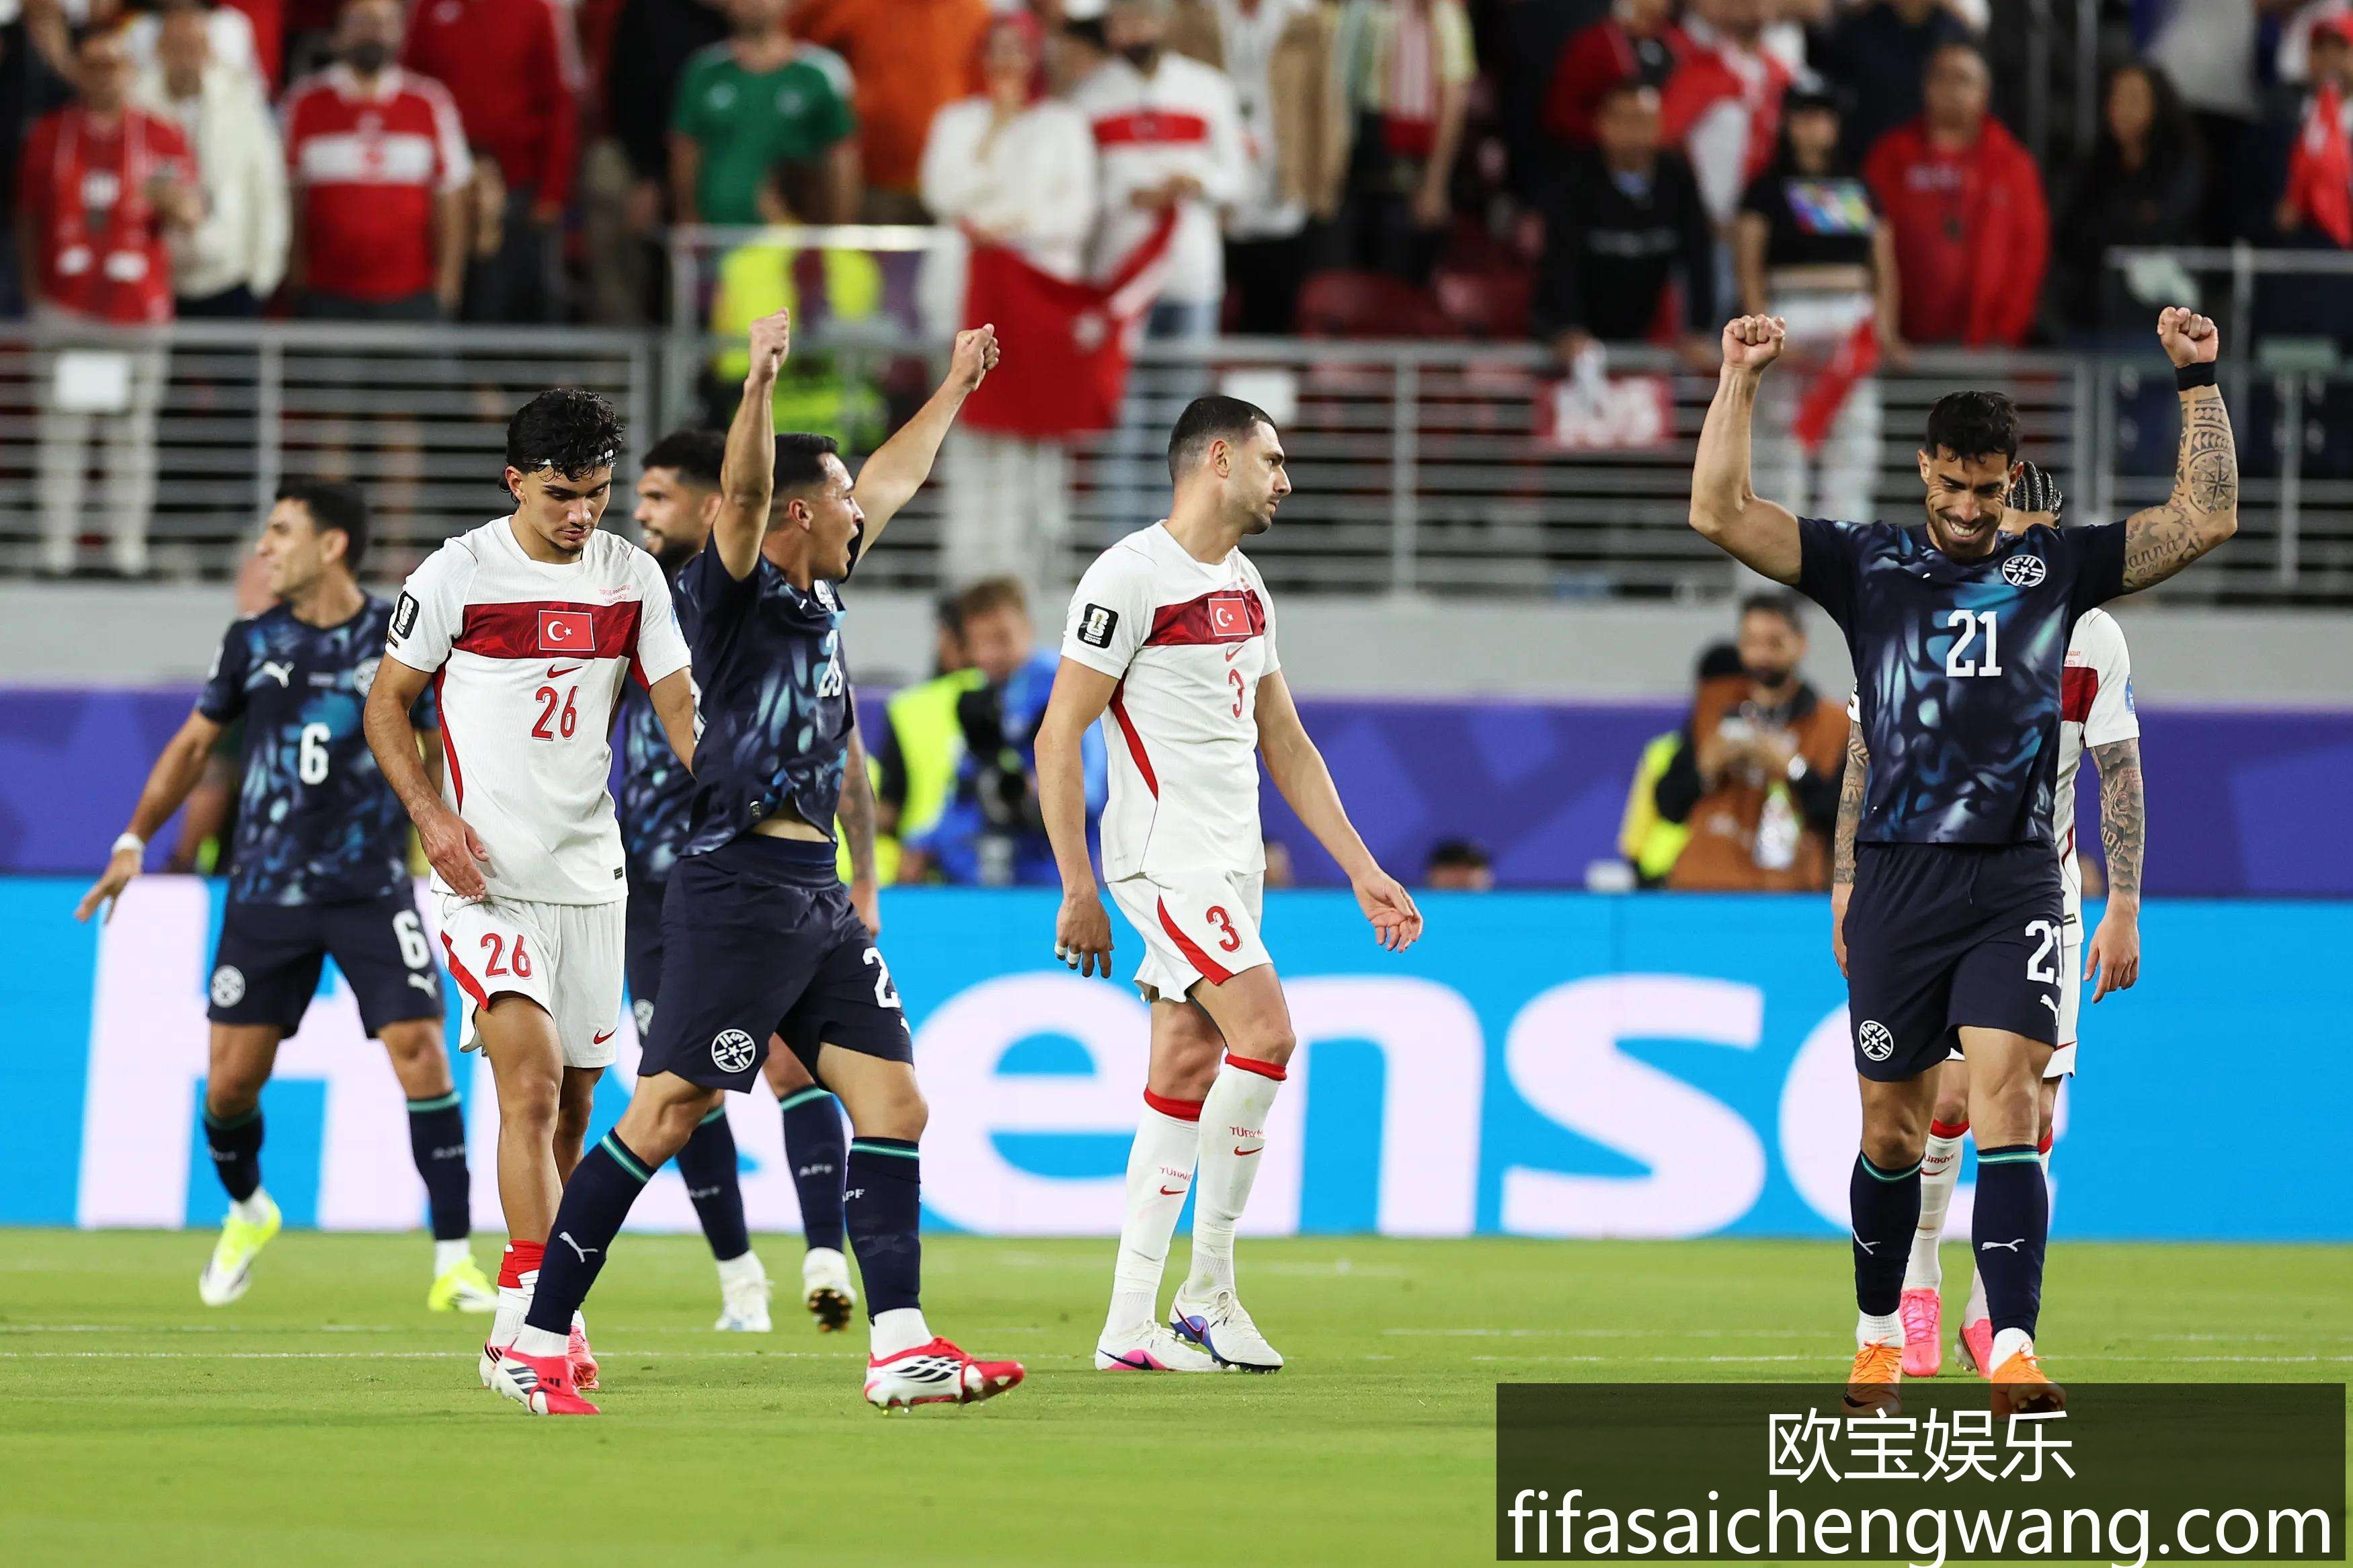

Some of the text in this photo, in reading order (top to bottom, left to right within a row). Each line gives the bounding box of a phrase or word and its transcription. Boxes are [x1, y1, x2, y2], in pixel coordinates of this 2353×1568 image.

[1946, 609, 2003, 677] 21
[531, 686, 579, 741] 26
[1228, 668, 1245, 720] 3
[299, 721, 332, 785] 6
[393, 909, 431, 970] 6
[480, 933, 533, 980] 26
[1205, 905, 1243, 952] 3
[2025, 919, 2063, 989] 21
[77, 874, 2072, 1237] Hens
